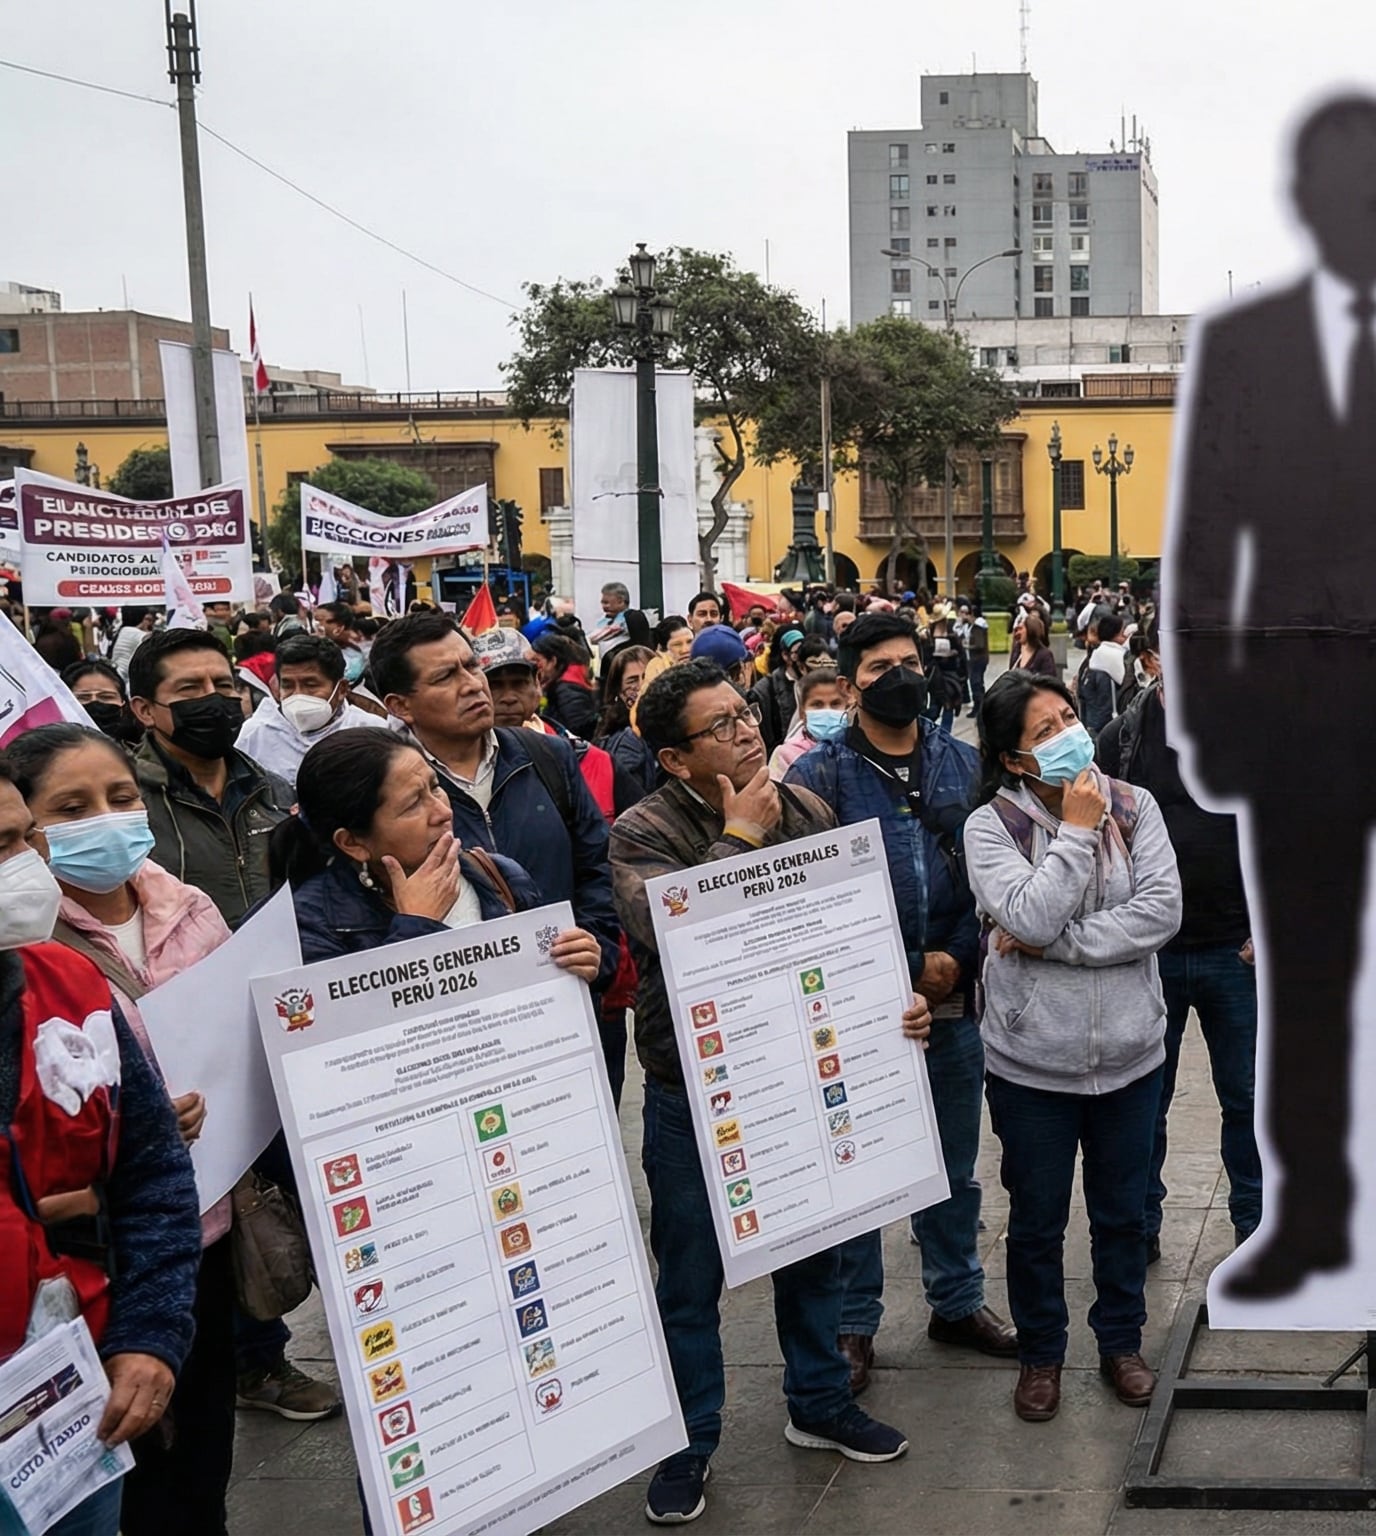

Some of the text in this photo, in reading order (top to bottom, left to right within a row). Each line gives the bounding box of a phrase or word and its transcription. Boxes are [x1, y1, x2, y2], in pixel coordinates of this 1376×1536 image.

[46, 551, 158, 564] CANDIDATOS AL
[697, 843, 840, 894] ELECCIONES GENERALES
[742, 871, 807, 899] PERÚ 2026
[327, 935, 521, 1001] ELECCIONES GENERALES
[391, 971, 478, 1008] PERÚ 2026
